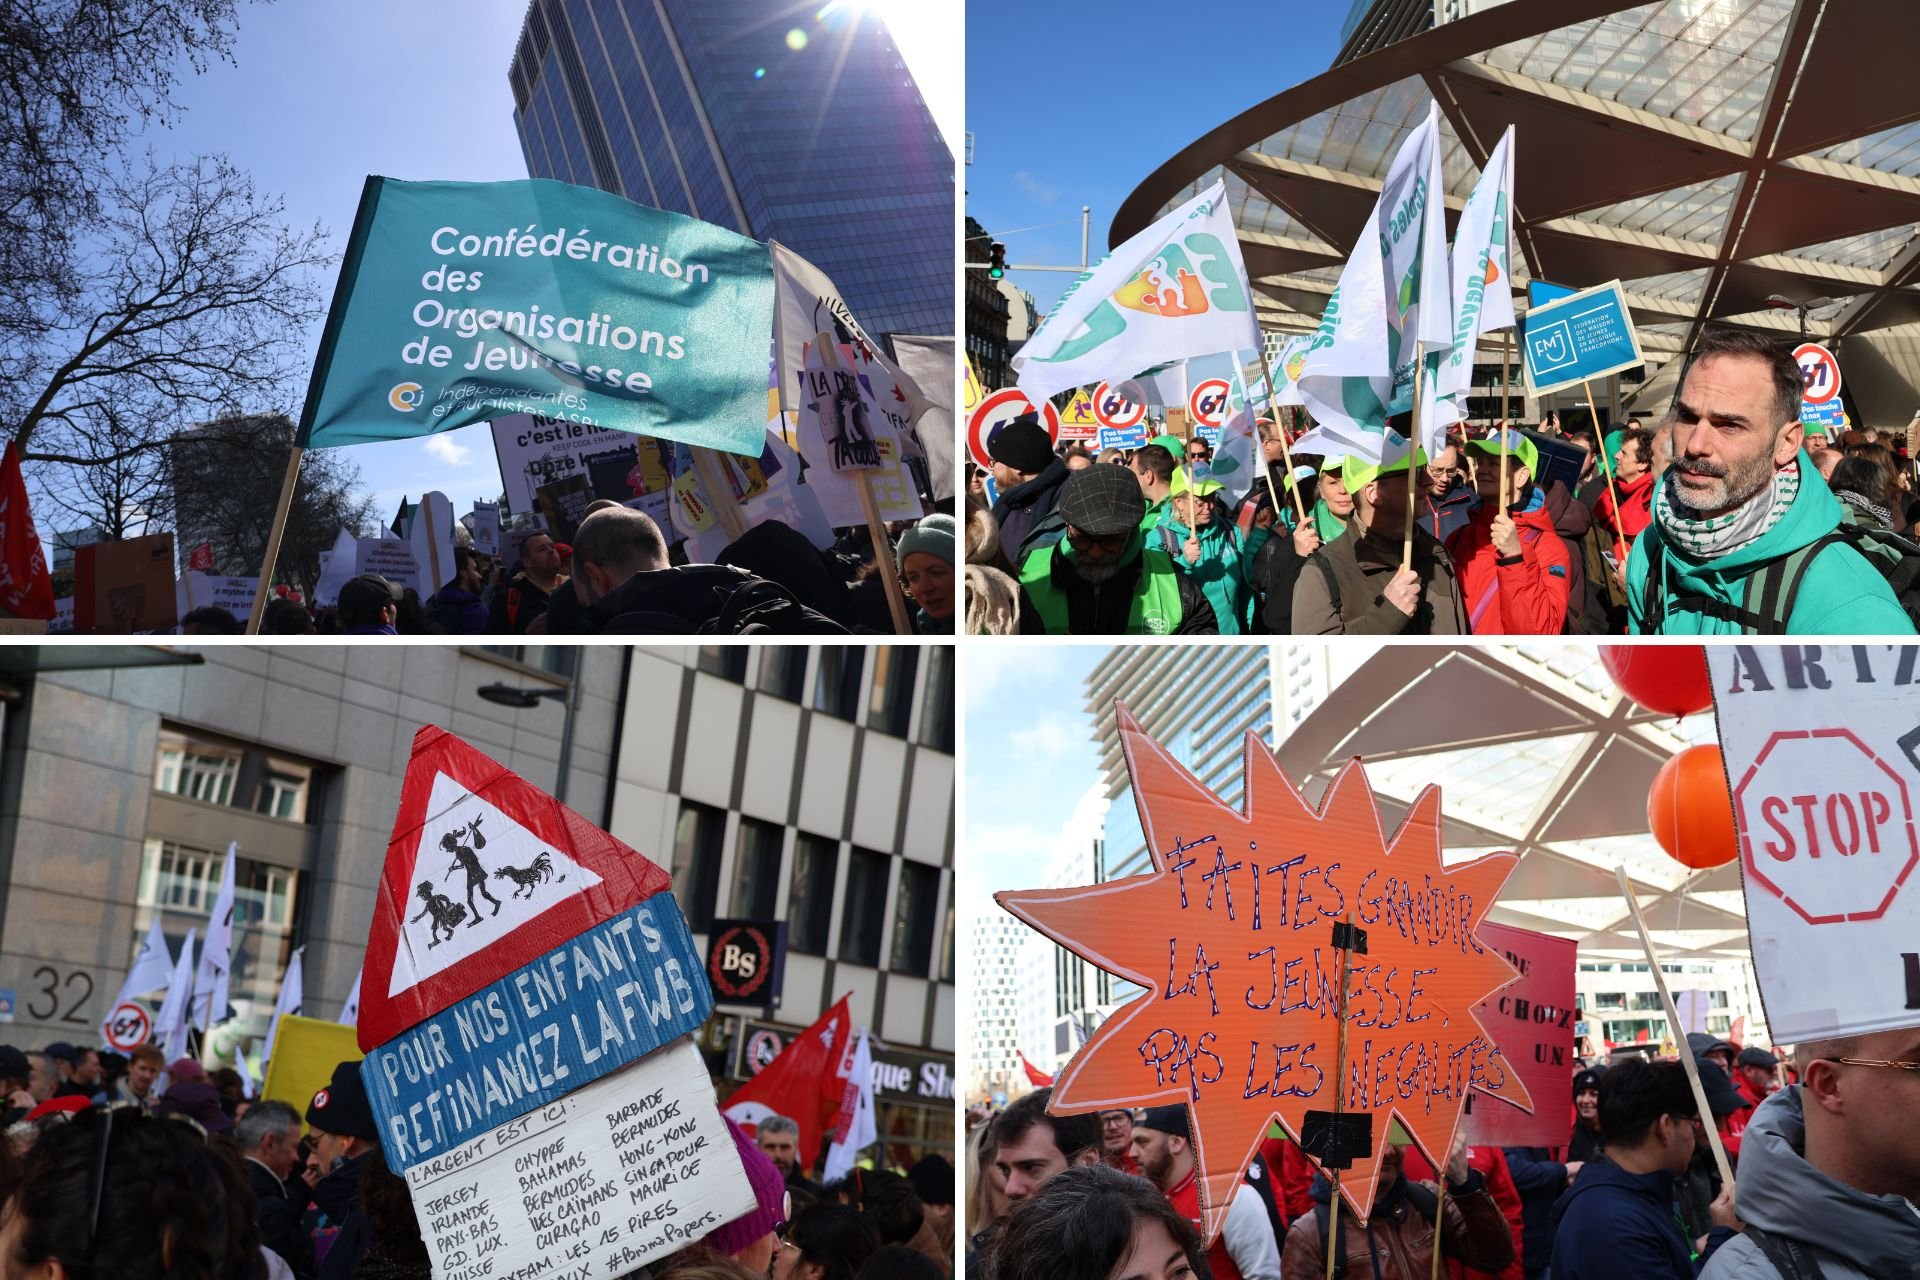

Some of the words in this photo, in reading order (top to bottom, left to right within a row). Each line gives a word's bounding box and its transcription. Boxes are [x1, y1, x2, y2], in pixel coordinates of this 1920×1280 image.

[430, 224, 710, 284] Confédération
[422, 264, 484, 292] des
[413, 299, 687, 361] Organisations
[1535, 330, 1566, 362] FMJ
[402, 336, 453, 368] de
[464, 341, 652, 394] Jeunesse
[1801, 363, 1828, 388] 67
[438, 383, 588, 412] Indépendantes
[1103, 396, 1134, 416] 67
[1200, 394, 1227, 414] 67
[1801, 405, 1815, 413] Pas
[1815, 403, 1839, 412] touche
[567, 425, 583, 440] le
[1761, 791, 1891, 862] STOP
[27, 966, 94, 1025] 32
[1164, 938, 1220, 1018] LA
[382, 1023, 453, 1098] POUR
[454, 991, 510, 1052] NOS
[515, 908, 662, 1020] ENFANTS
[113, 1017, 143, 1039] 67
[1138, 1028, 1225, 1103] PAS
[1243, 1040, 1324, 1100] LES
[1535, 1043, 1565, 1067] UN
[606, 1087, 664, 1130] BARBADE
[611, 1099, 681, 1149] BERMUDES
[411, 1138, 486, 1184] L'ARGENT
[496, 1116, 532, 1146] EST
[515, 1136, 566, 1174] CHYPRE
[619, 1117, 697, 1168] HONG-KONG
[518, 1151, 587, 1195] BAHAMAS
[523, 1169, 596, 1216] BERMUDES
[424, 1182, 479, 1217] JERSEY
[431, 1199, 490, 1235] IRLANDE
[536, 1211, 601, 1251] CURAÇAO
[565, 1240, 592, 1261] LES
[600, 1225, 620, 1247] 15
